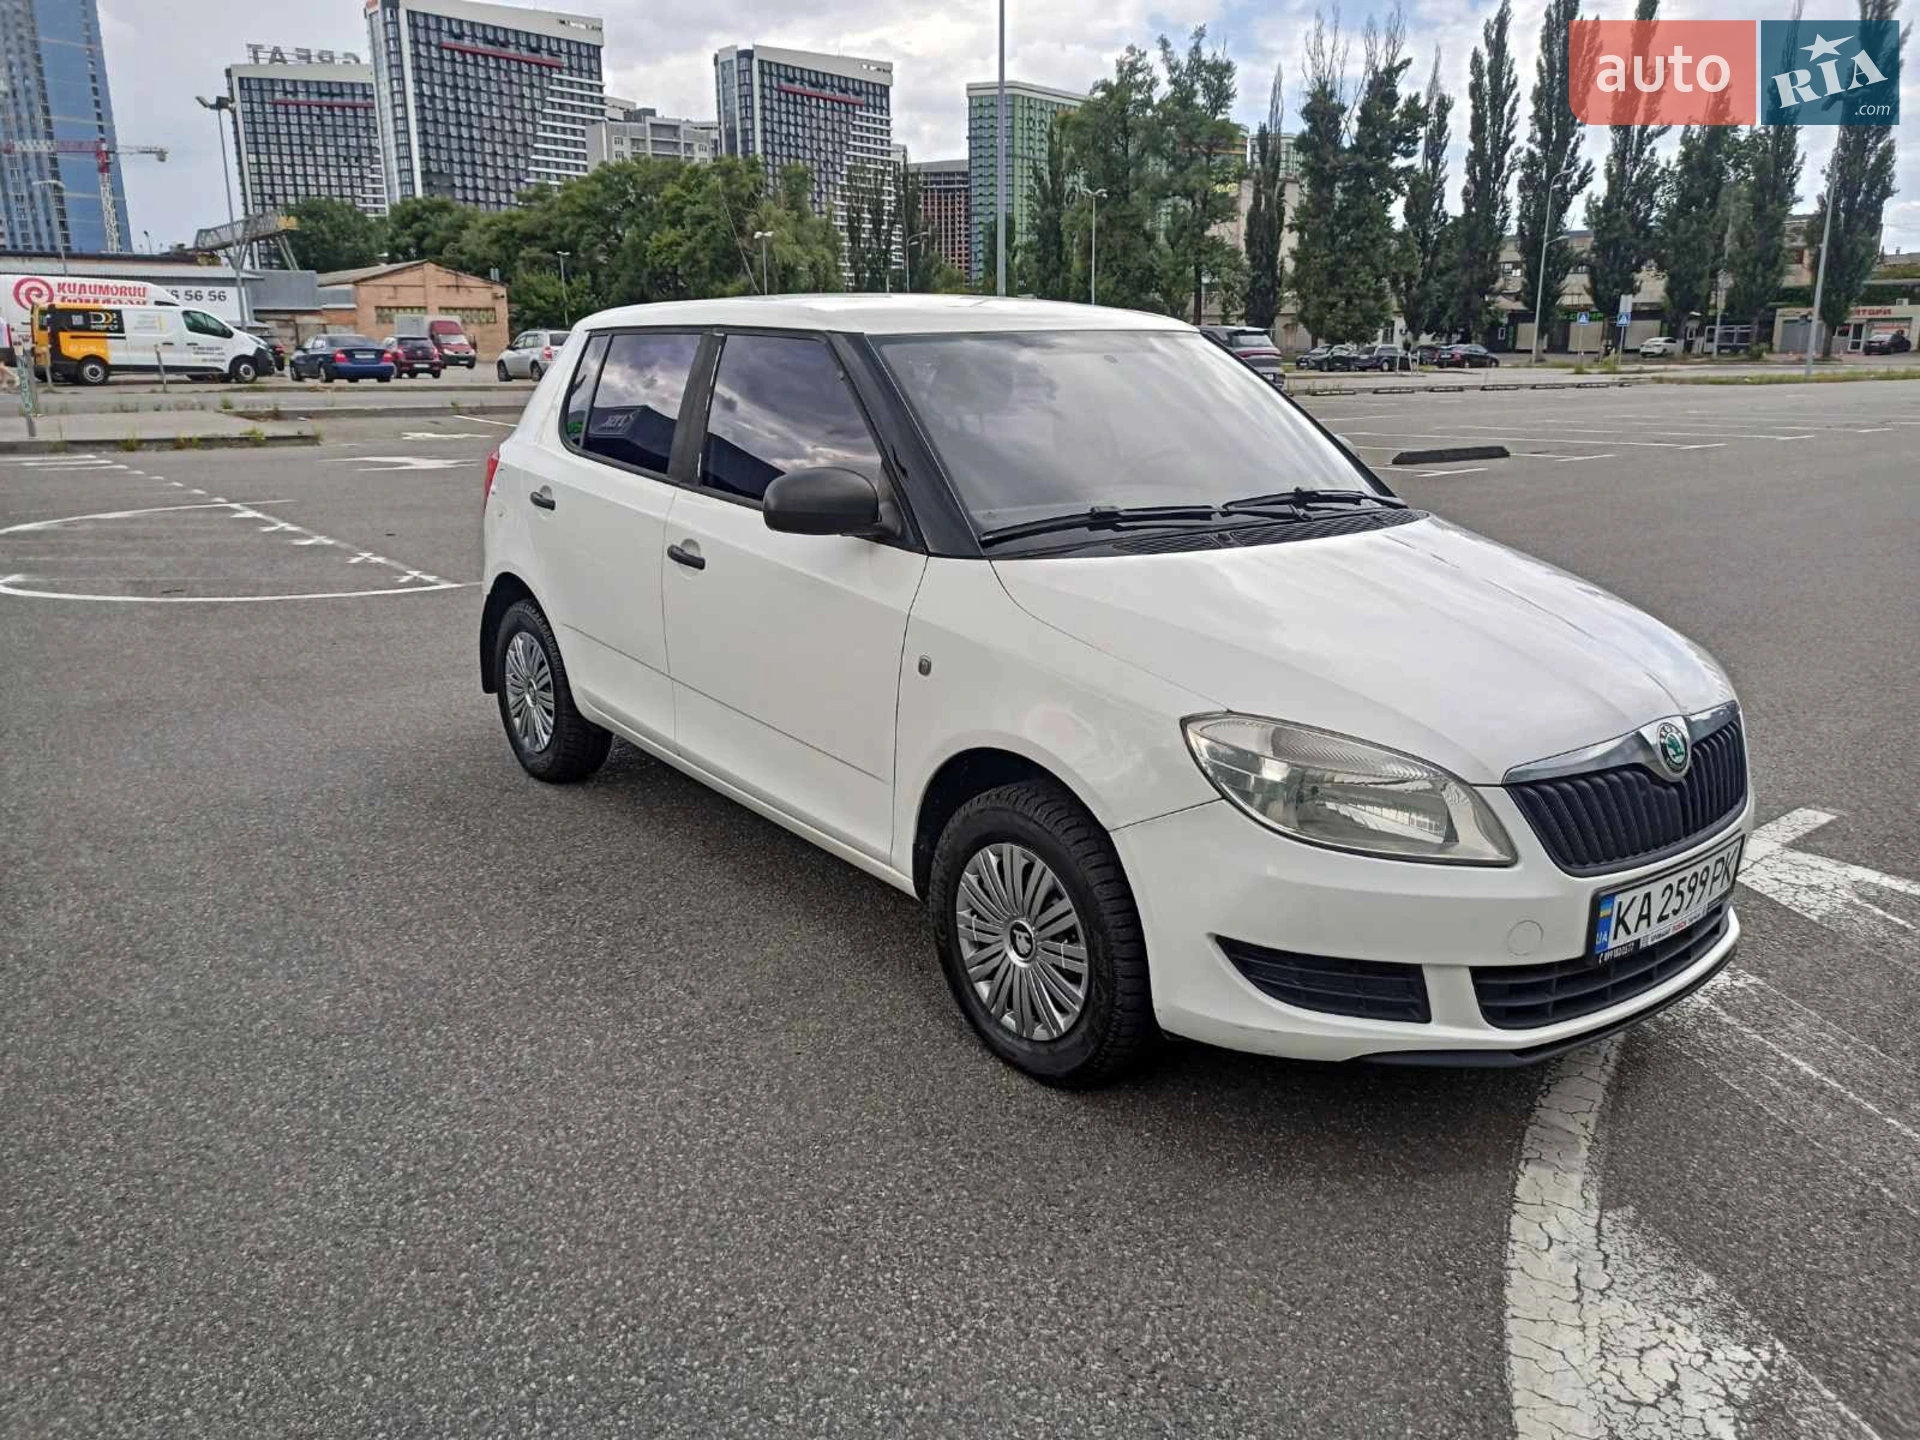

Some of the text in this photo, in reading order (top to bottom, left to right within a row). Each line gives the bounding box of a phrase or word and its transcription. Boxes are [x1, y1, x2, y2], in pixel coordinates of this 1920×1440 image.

[184, 289, 204, 302] 56
[207, 290, 227, 302] 56
[1613, 891, 1652, 941] KA
[1657, 865, 1710, 924] 2599
[1596, 931, 1608, 945] UA
